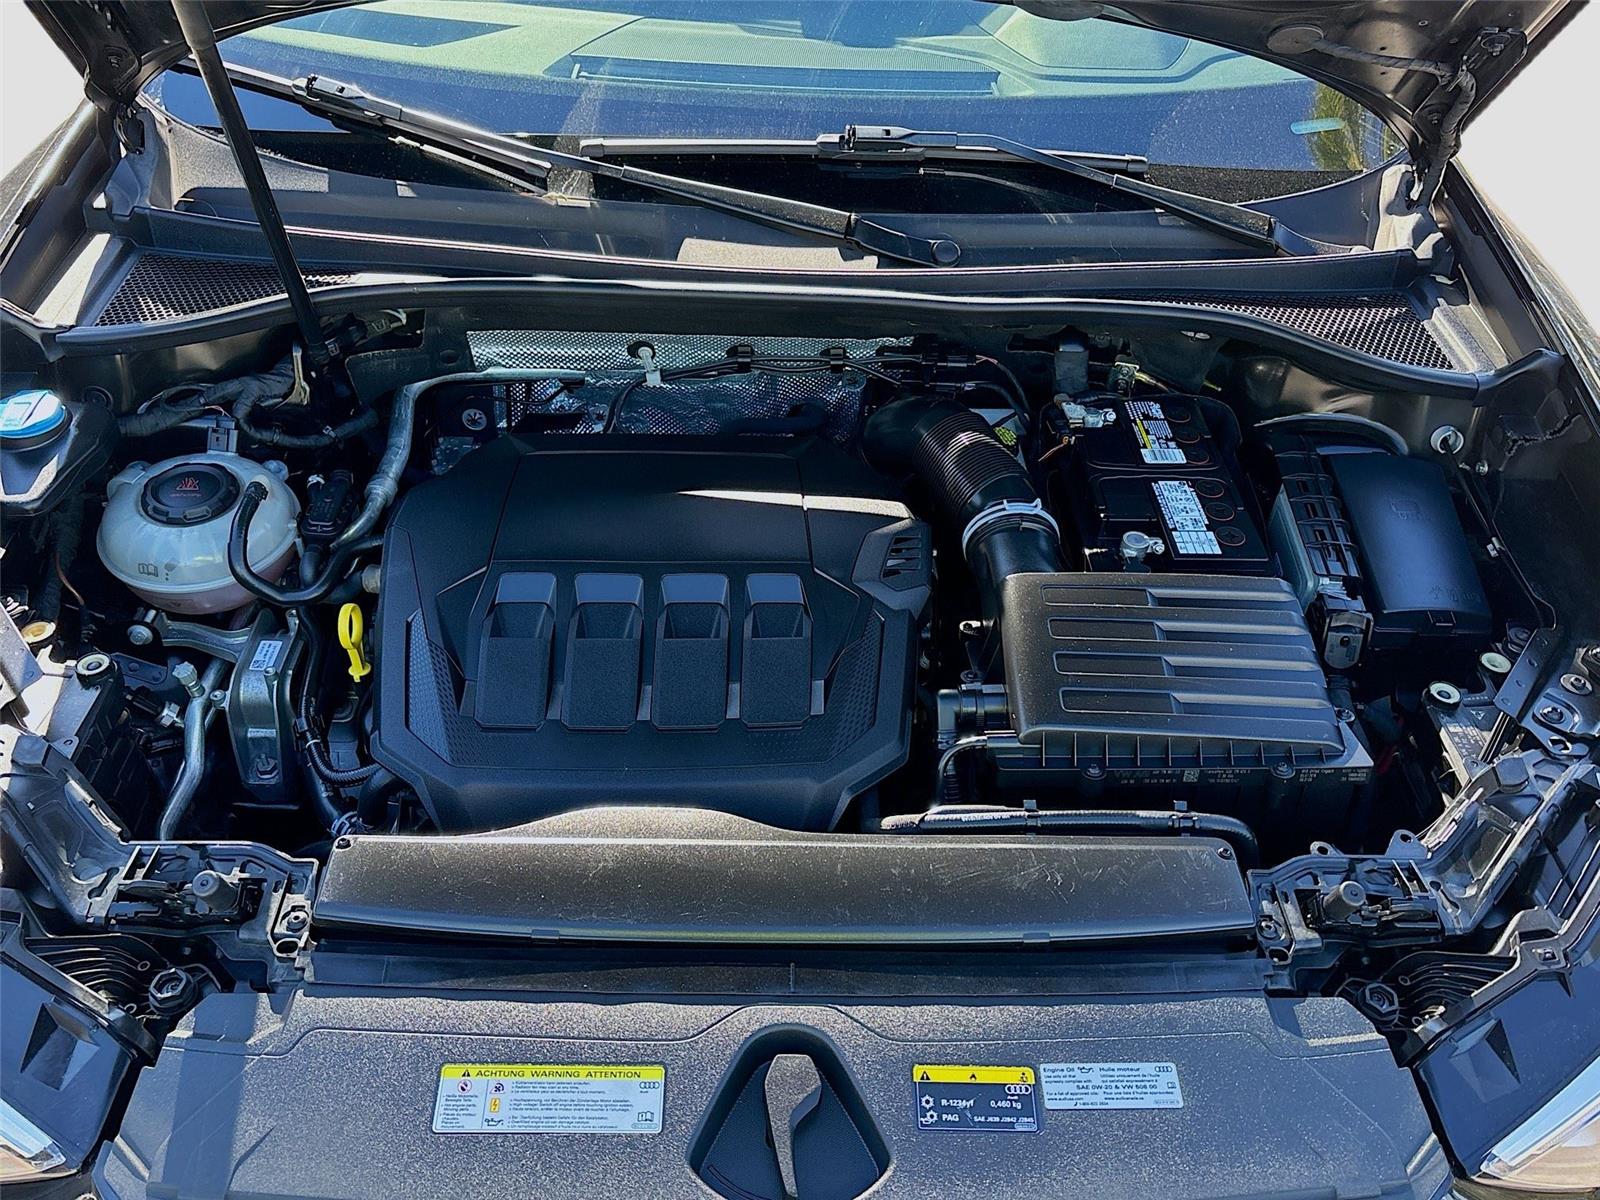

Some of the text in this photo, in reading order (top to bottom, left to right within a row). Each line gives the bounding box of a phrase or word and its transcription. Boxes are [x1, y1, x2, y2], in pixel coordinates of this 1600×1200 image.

[475, 1070, 641, 1078] ACHTUNG WARNING ATTENTION
[1012, 1100, 1022, 1109] kg
